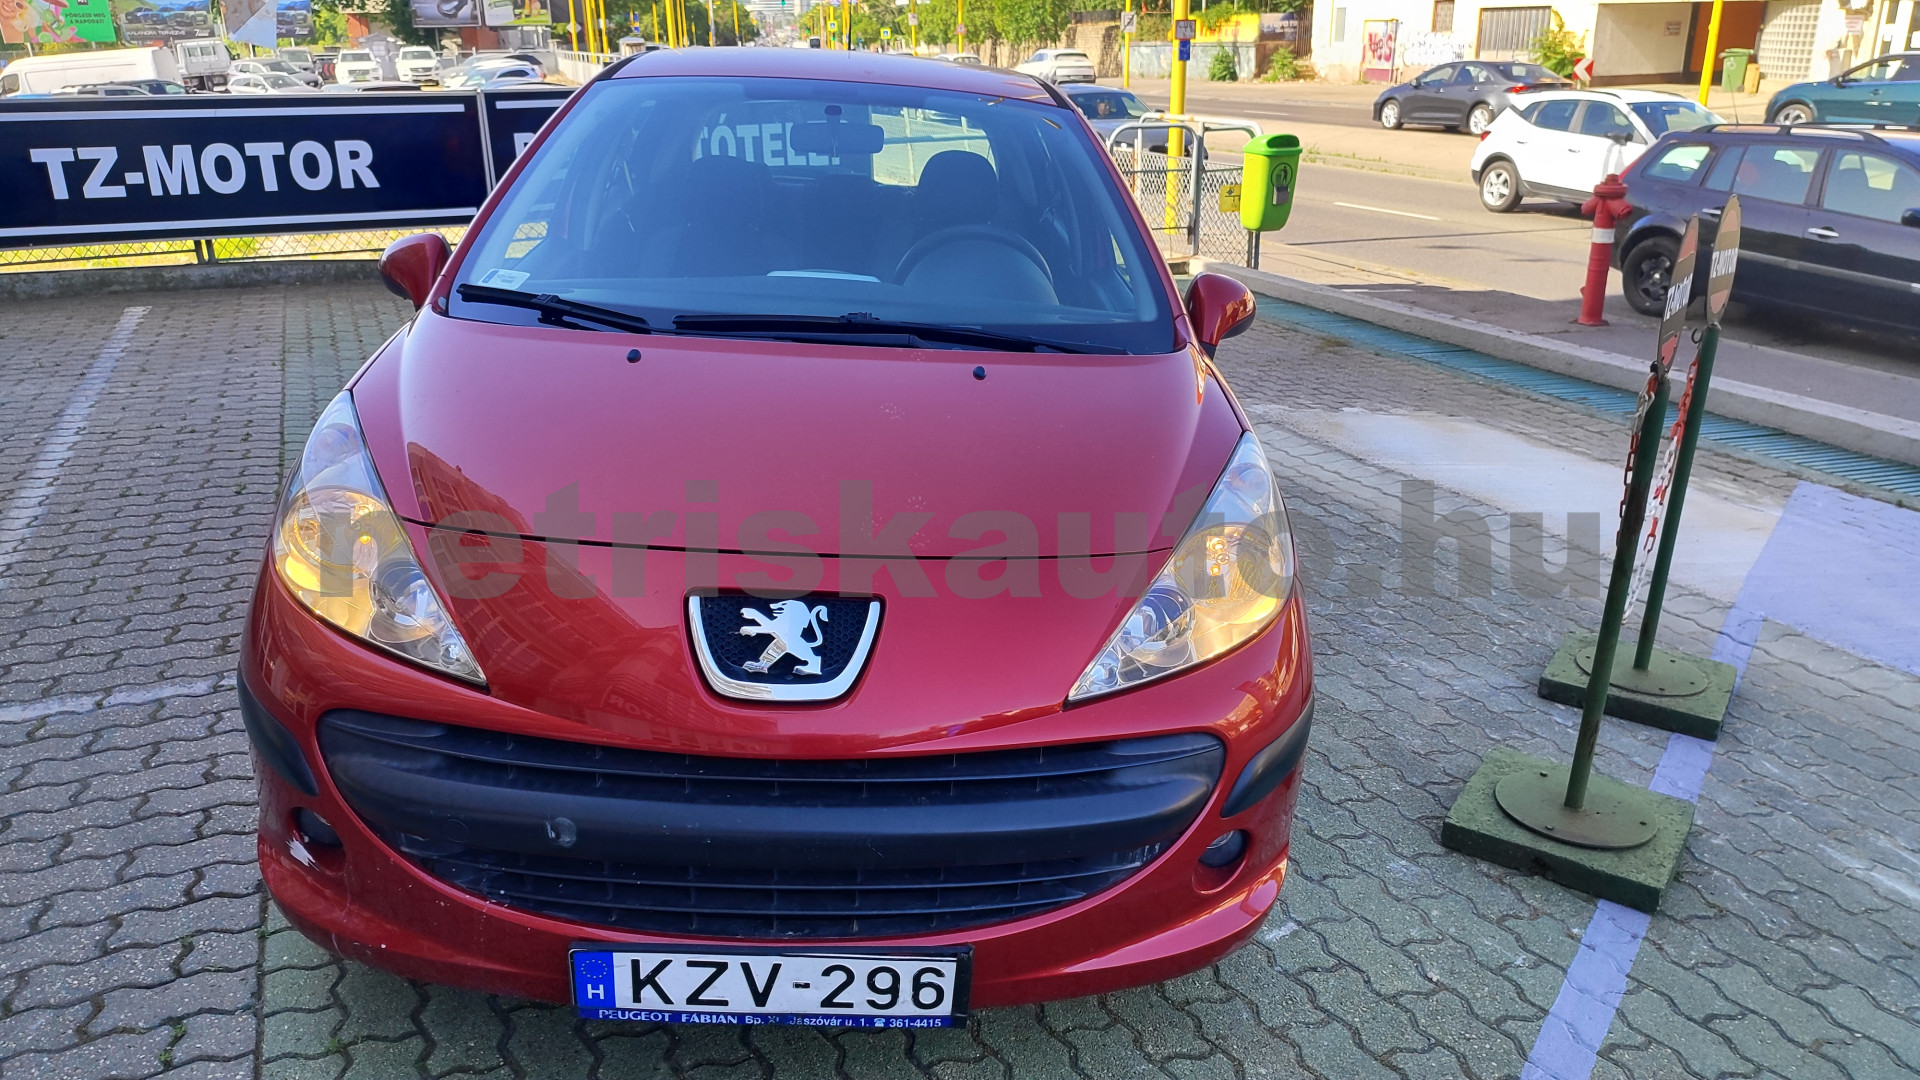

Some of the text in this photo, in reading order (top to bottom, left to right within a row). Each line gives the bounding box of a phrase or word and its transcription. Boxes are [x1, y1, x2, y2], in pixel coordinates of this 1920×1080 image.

[30, 140, 380, 199] TZ-MOTOR
[587, 984, 605, 1000] H
[631, 959, 946, 1010] KZV-296
[599, 1009, 673, 1023] PEUGEOT
[745, 1015, 765, 1025] Bp.
[845, 1018, 856, 1026] u.
[860, 1018, 870, 1027] 1.
[889, 1018, 942, 1028] 361-4415
